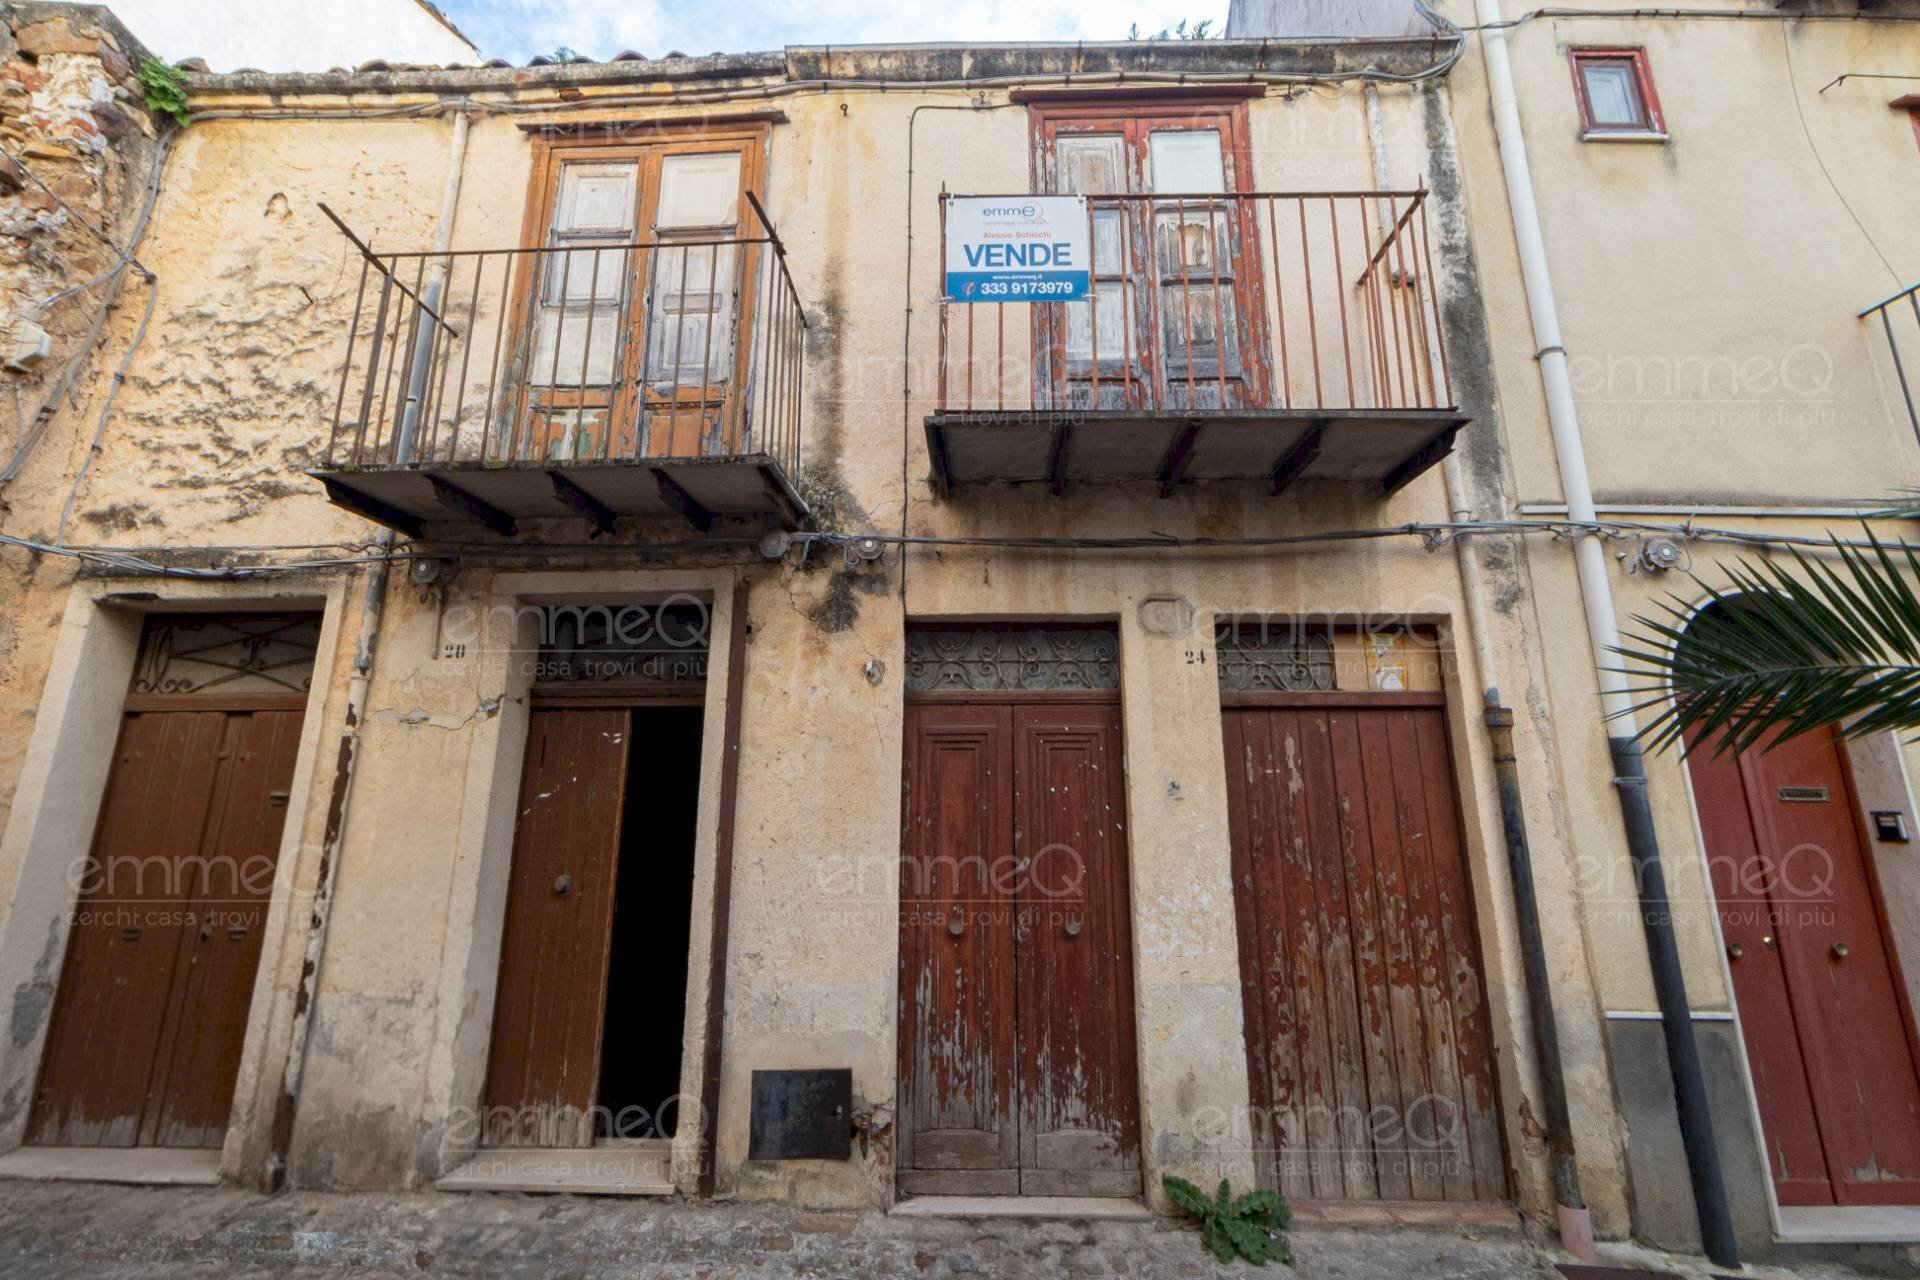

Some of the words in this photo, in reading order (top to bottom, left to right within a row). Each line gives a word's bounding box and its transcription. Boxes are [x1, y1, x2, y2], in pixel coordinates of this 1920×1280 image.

[963, 243, 1072, 267] VENDE
[981, 282, 1008, 294] 333
[1011, 282, 1073, 294] 9173979
[1185, 649, 1206, 664] 24
